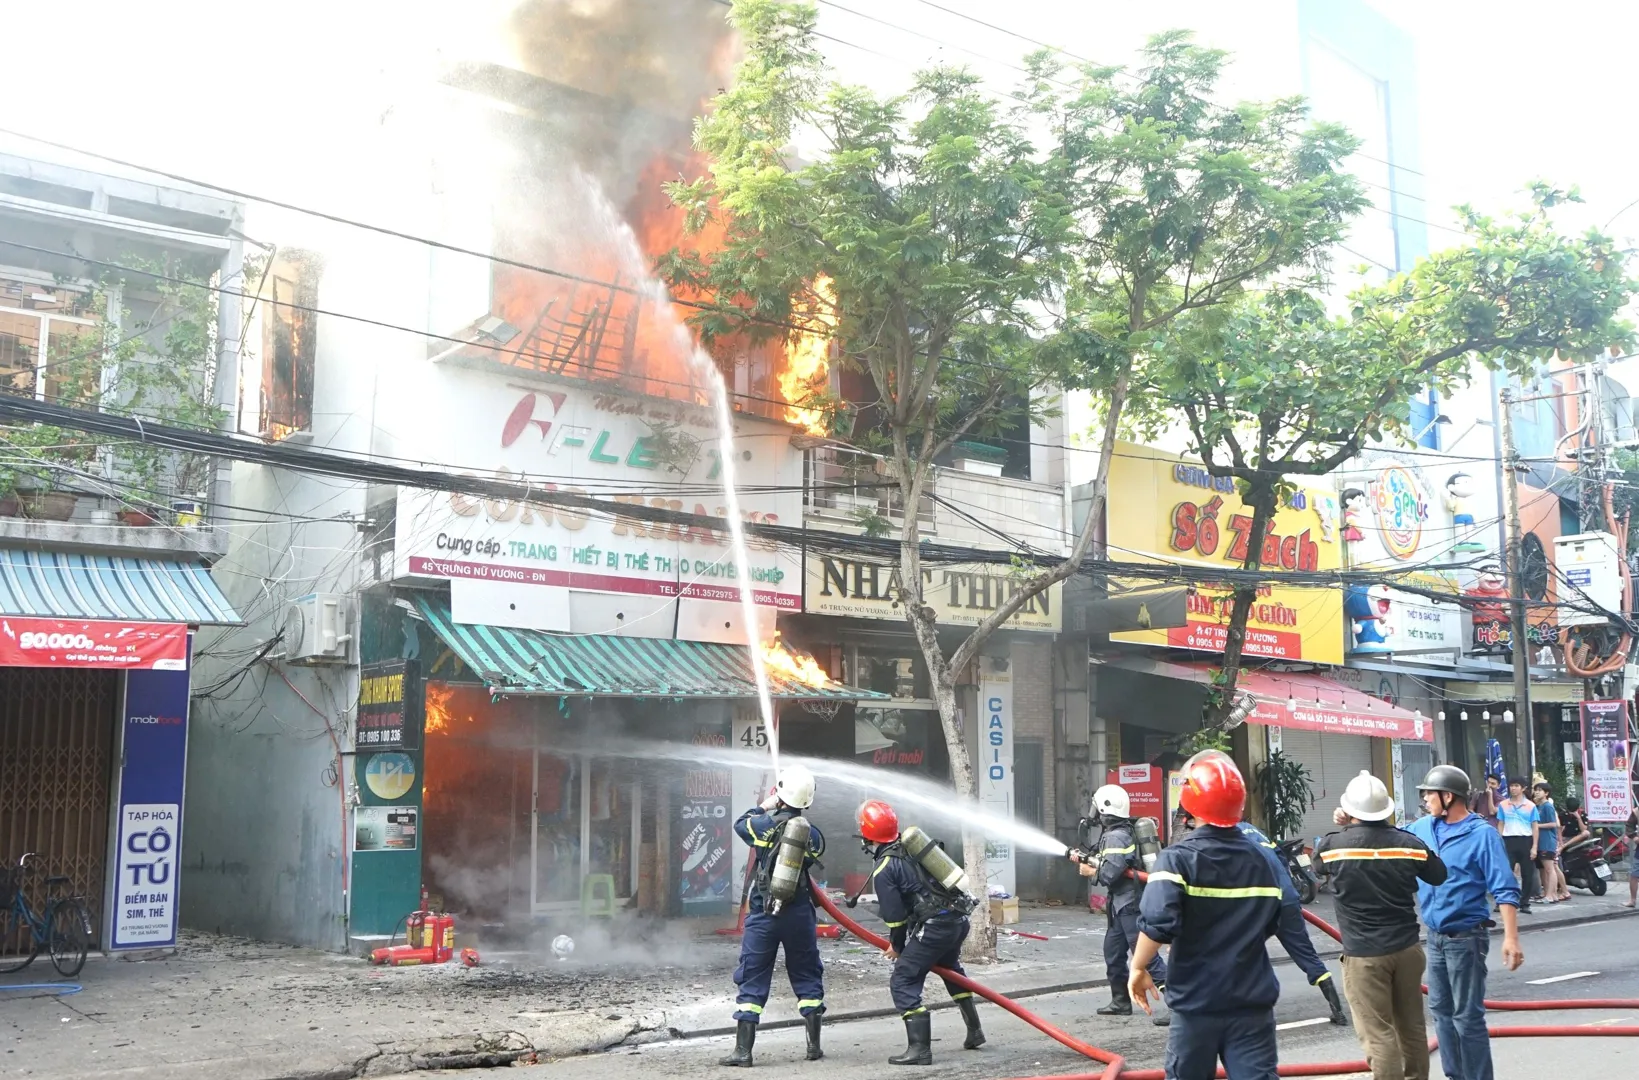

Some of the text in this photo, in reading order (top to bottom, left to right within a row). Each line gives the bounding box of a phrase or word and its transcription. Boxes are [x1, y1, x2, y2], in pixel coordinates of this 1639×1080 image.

[1171, 495, 1224, 556] Số
[436, 532, 473, 555] Cung
[508, 541, 557, 561] TRANG
[606, 551, 619, 570] BỊ
[421, 562, 434, 572] 45
[436, 563, 471, 576] TRƯNG
[474, 565, 488, 577] NỮ
[491, 568, 524, 580] VƯƠNG
[532, 573, 546, 582] ĐN
[659, 585, 679, 595] TEL:
[829, 604, 853, 612] TRƯNG
[865, 607, 889, 615] VƯƠNG
[1256, 601, 1297, 627] GIÒN
[1204, 627, 1213, 637] 47
[1253, 632, 1278, 644] VƯƠNG
[130, 715, 182, 725] mobifone
[367, 730, 379, 742] 0905
[381, 729, 389, 741] 100
[390, 729, 401, 741] 336
[740, 726, 768, 747] 45
[987, 697, 1004, 781] CASIO
[1589, 783, 1602, 800] 6
[1602, 790, 1626, 801] Triệu
[128, 809, 173, 823] TẠP HÓA
[1611, 805, 1629, 816] 0%
[127, 826, 171, 853] CÔ
[682, 823, 707, 851] WHITE
[702, 846, 726, 873] PEARL
[126, 856, 170, 886] TÚ
[125, 890, 168, 904] ĐIỂM BÁN
[126, 904, 164, 919] SIM, THẺ
